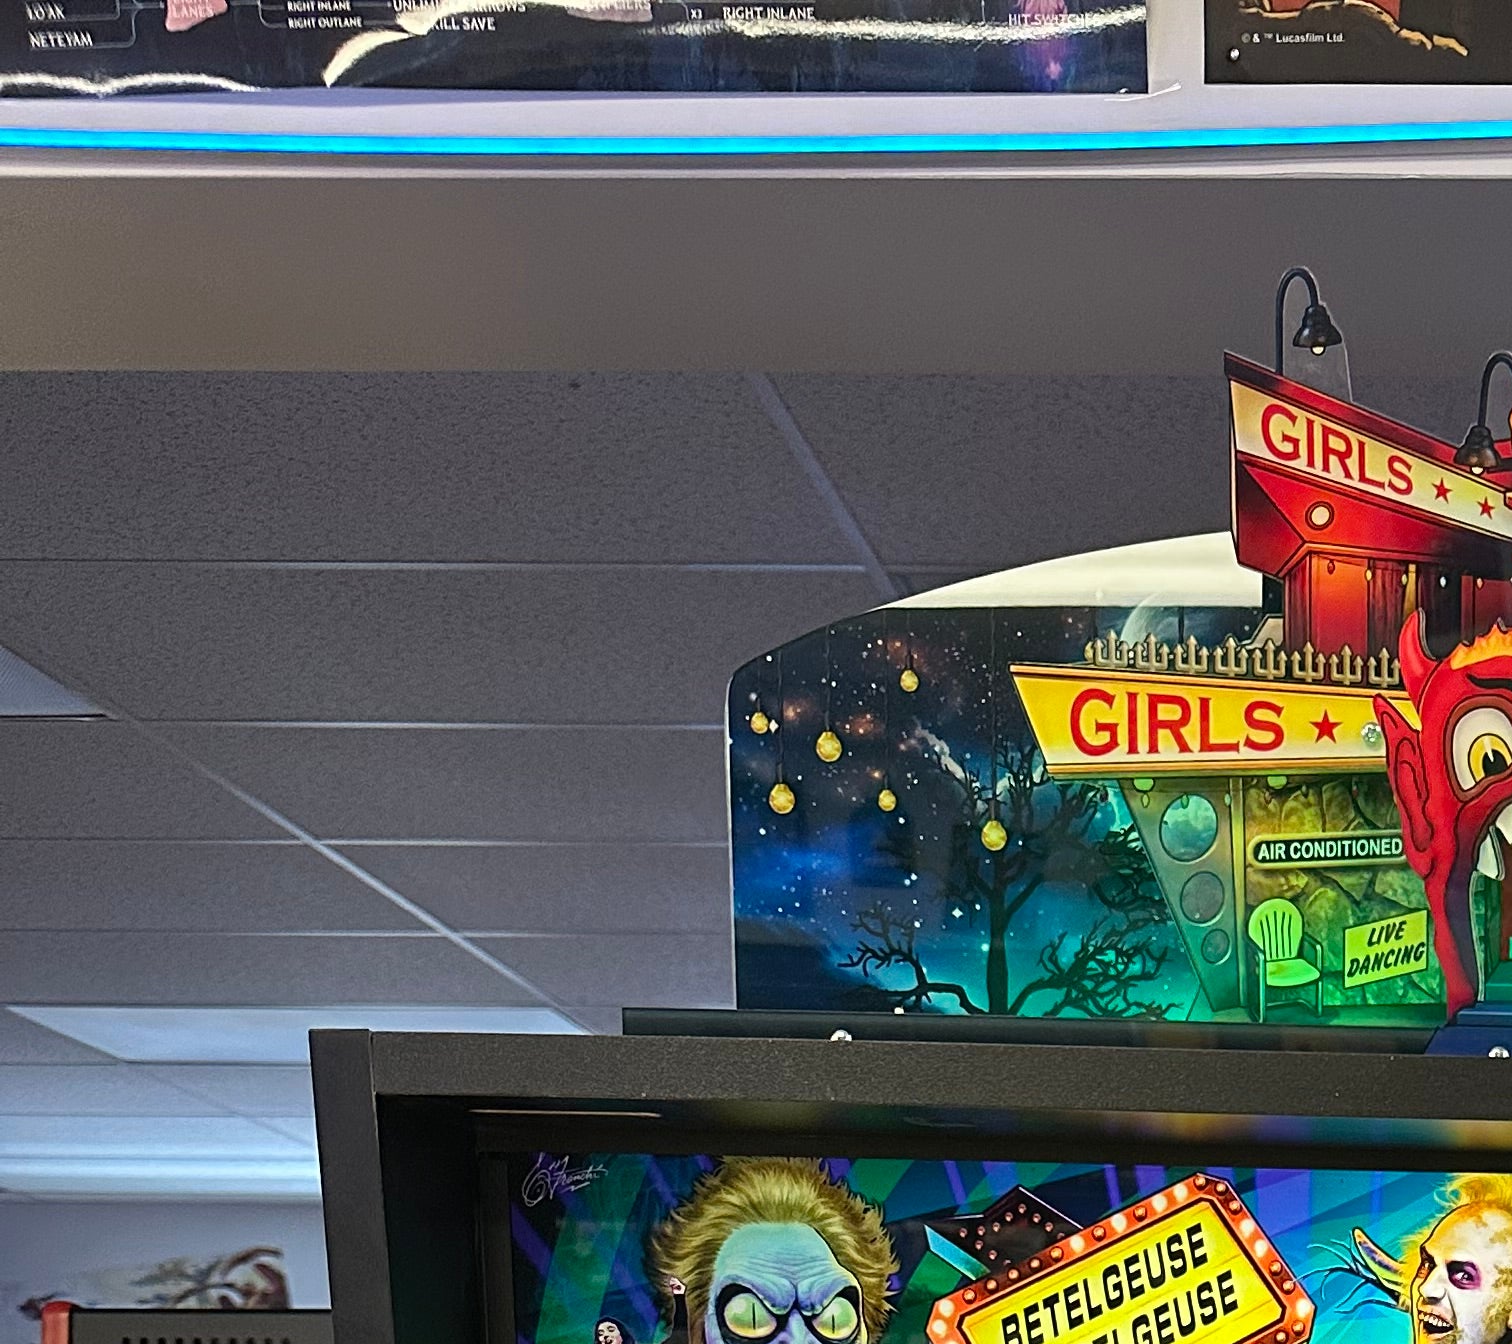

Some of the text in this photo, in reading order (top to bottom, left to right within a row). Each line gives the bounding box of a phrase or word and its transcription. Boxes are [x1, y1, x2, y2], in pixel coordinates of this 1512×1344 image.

[287, 16, 363, 29] RIGHT OUTLANE
[723, 6, 816, 20] RIGHT INLANE
[462, 17, 496, 31] SAVE
[30, 31, 94, 48] NETEYAM
[1276, 32, 1325, 44] Lucasfilm
[1326, 32, 1346, 44] Ltd.
[1259, 402, 1416, 500] GIRLS
[1068, 688, 1286, 758] GIRLS
[1257, 836, 1403, 862] AIR CONDITIONED
[1367, 919, 1407, 948] LIVE
[1346, 940, 1427, 978] DANCING
